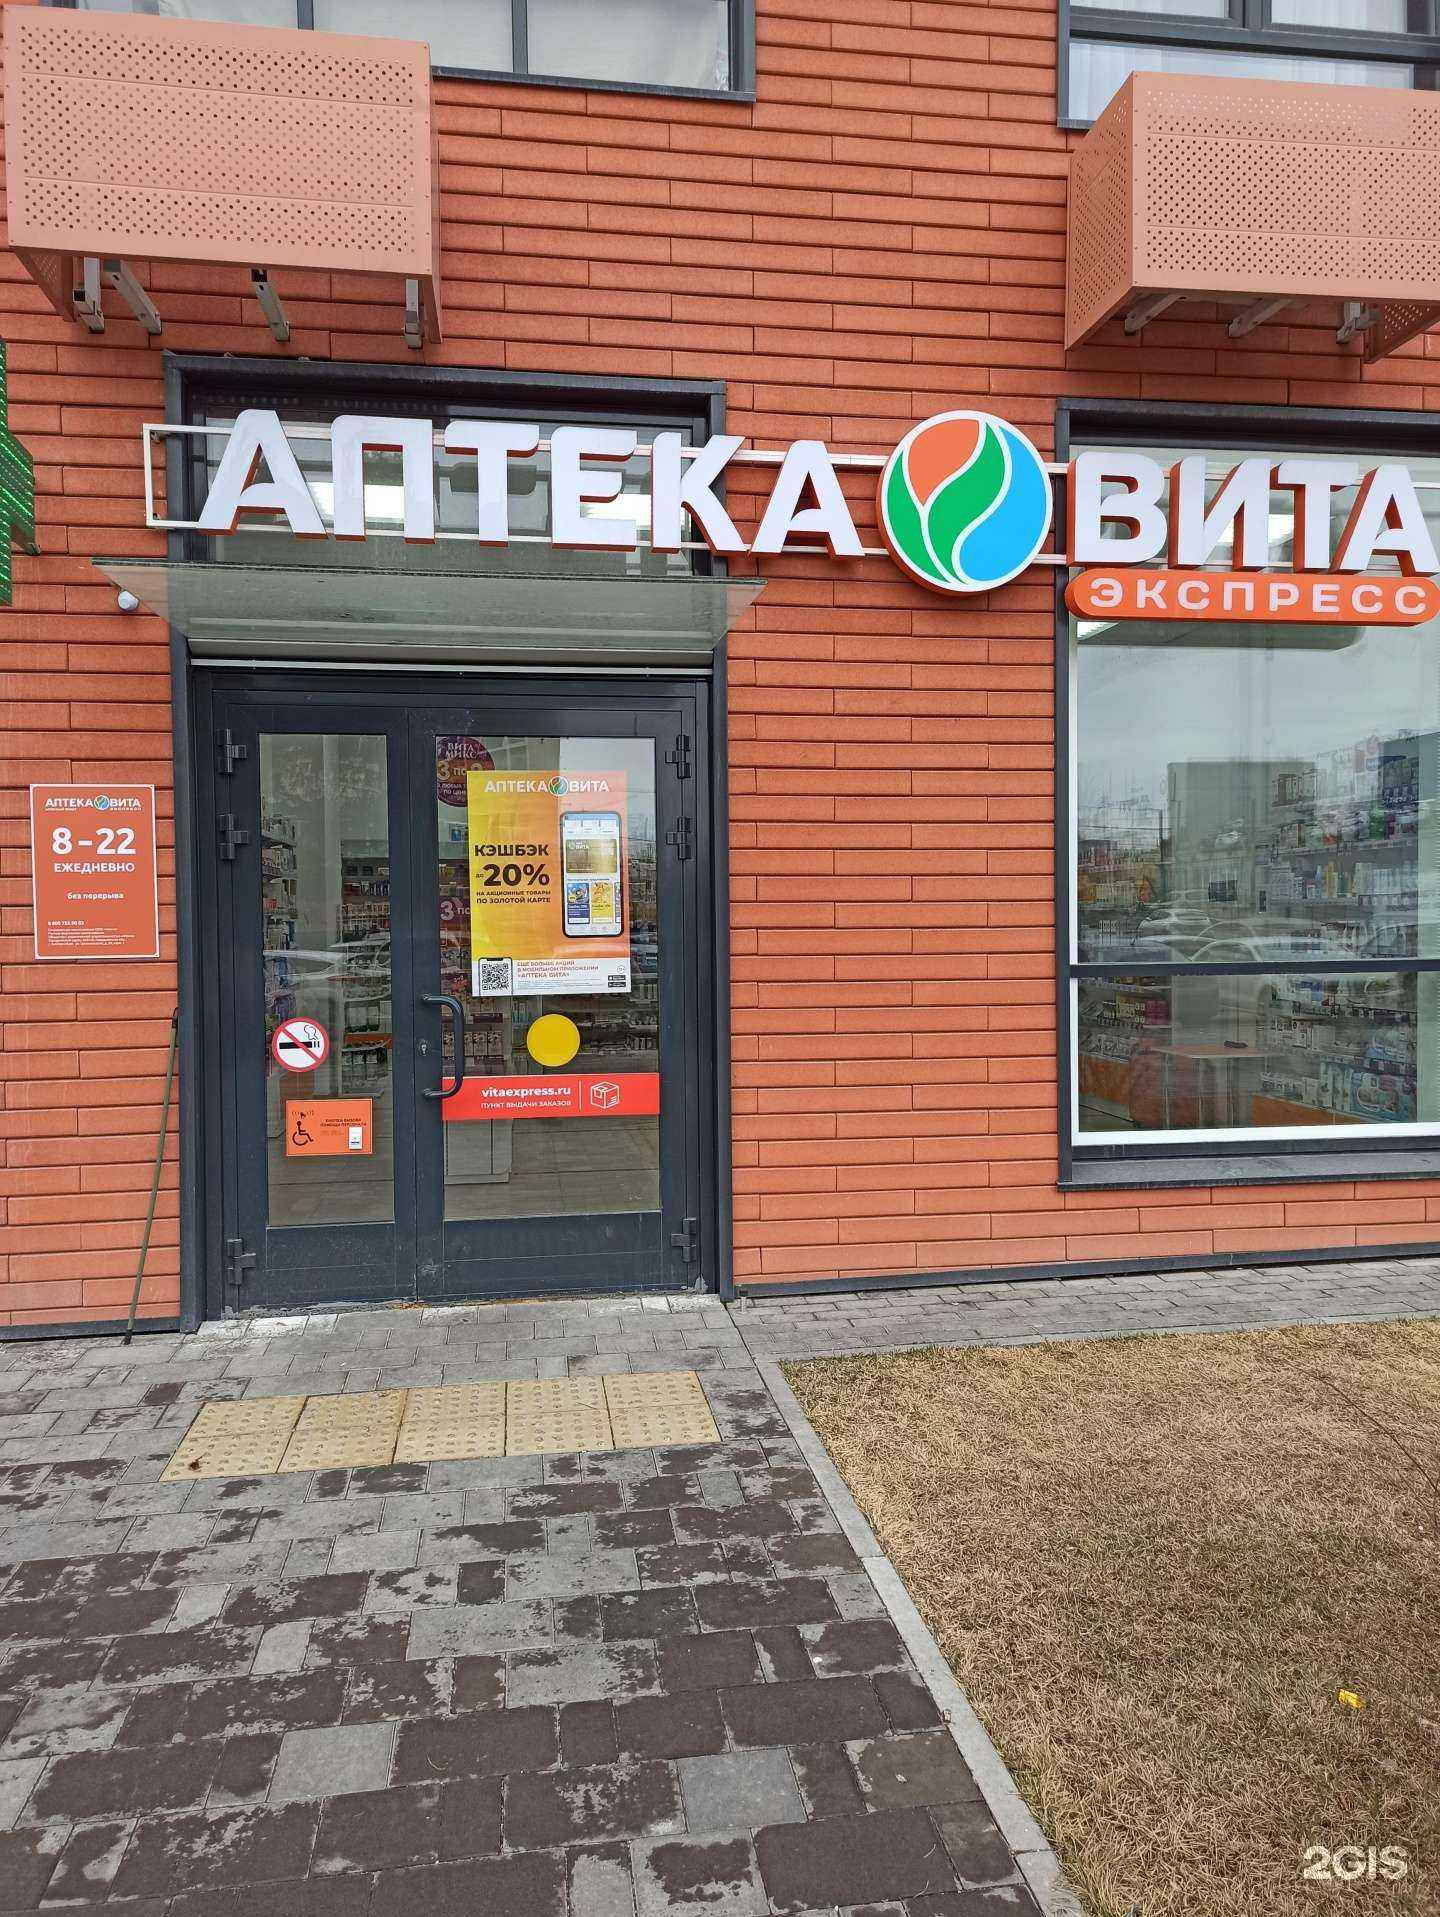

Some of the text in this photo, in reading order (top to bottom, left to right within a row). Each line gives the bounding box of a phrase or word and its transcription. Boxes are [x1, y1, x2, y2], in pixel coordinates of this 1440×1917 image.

[197, 408, 1440, 575] АПТЕКА ВИТА
[1089, 577, 1428, 616] ЭКСПРЕСС
[437, 760, 451, 780] 3
[484, 780, 610, 793] АПТЕКА ВИТА
[45, 798, 141, 808] АПТЕКА ВИТА
[474, 844, 549, 857] КЭШБЭК
[54, 862, 136, 874] ЕЖЕДНЕВНО
[483, 863, 550, 886] 20%
[67, 891, 124, 901] без перерыва
[489, 896, 526, 904] ЗОЛОТОЙ
[440, 900, 455, 921] 3
[481, 1086, 571, 1098] vitaexpress.ru
[506, 1101, 537, 1109] ВЫДАЧИ
